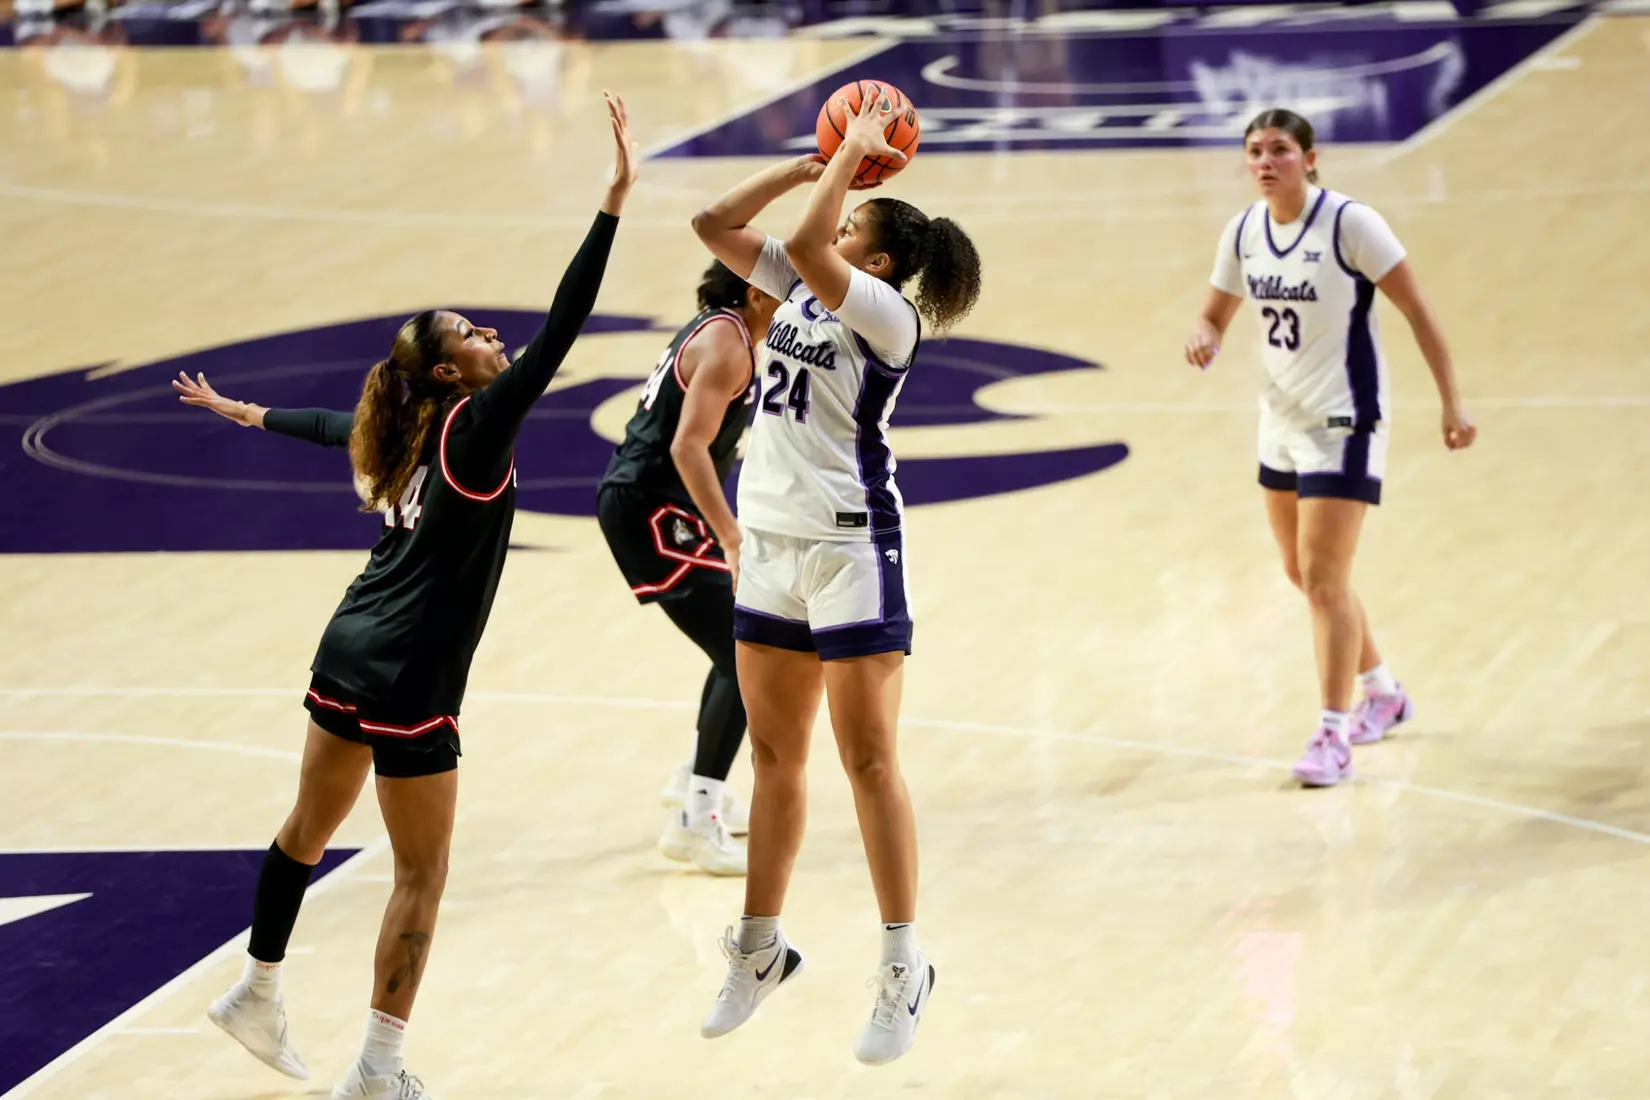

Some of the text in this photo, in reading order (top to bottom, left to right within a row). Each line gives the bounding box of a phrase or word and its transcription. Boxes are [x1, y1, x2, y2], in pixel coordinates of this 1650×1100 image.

[1247, 273, 1318, 302] Wildcats
[1262, 306, 1300, 352] 23
[762, 359, 811, 424] 24
